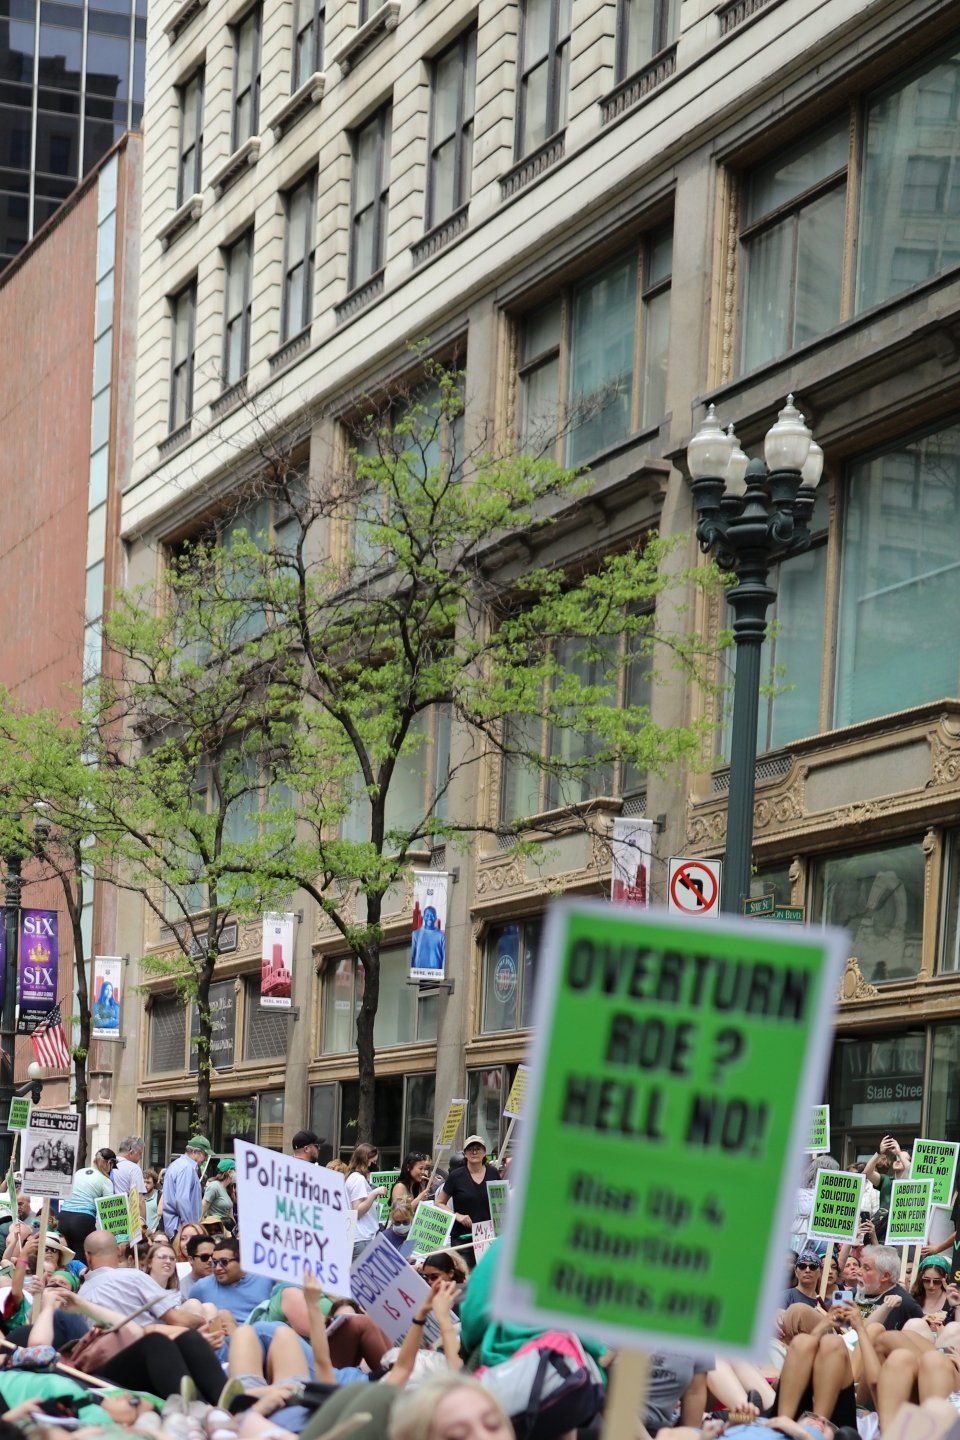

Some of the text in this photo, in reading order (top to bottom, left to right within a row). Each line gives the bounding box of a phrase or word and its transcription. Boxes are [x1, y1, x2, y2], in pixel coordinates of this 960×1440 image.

[23, 916, 55, 936] SIX
[23, 966, 54, 986] SIX
[565, 937, 815, 1023] OVERTURN
[602, 1010, 747, 1081] ROE ?
[866, 1083, 923, 1100] State Stree
[32, 1112, 61, 1120] OVERTURN
[561, 1070, 770, 1160] HELL NO!
[31, 1119, 76, 1130] HELL NO!
[917, 1144, 954, 1156] OVERTURN
[923, 1156, 945, 1166] ROE ?
[917, 1164, 949, 1176] HELL NO!
[245, 1150, 342, 1211] Polititians
[822, 1175, 858, 1189] ¡ABORTO A
[820, 1189, 855, 1203] SOLICITUD
[896, 1184, 922, 1195] ¡ABORTO
[922, 1184, 927, 1193] A
[569, 1171, 636, 1217] Rise
[647, 1182, 690, 1226] Up
[896, 1197, 925, 1208] SOLICITUD
[275, 1195, 324, 1231] MAKE
[421, 1207, 448, 1224] ABORTION
[816, 1203, 856, 1216] Y SIN PEDIR
[892, 1210, 926, 1219] Y SIN PEDIR
[415, 1220, 447, 1235] ON DEMAND
[475, 1224, 488, 1238] My
[814, 1216, 854, 1231] DISCULPAS!
[890, 1223, 925, 1232] DISCULPAS!
[261, 1221, 329, 1262] CRAPPY
[418, 1232, 443, 1244] WITHOUT
[567, 1218, 710, 1273] Abortion
[253, 1241, 338, 1284] DOCTORS
[350, 1239, 407, 1311] ABORTION
[550, 1259, 723, 1329] Rights.org
[383, 1288, 416, 1321] IS A
